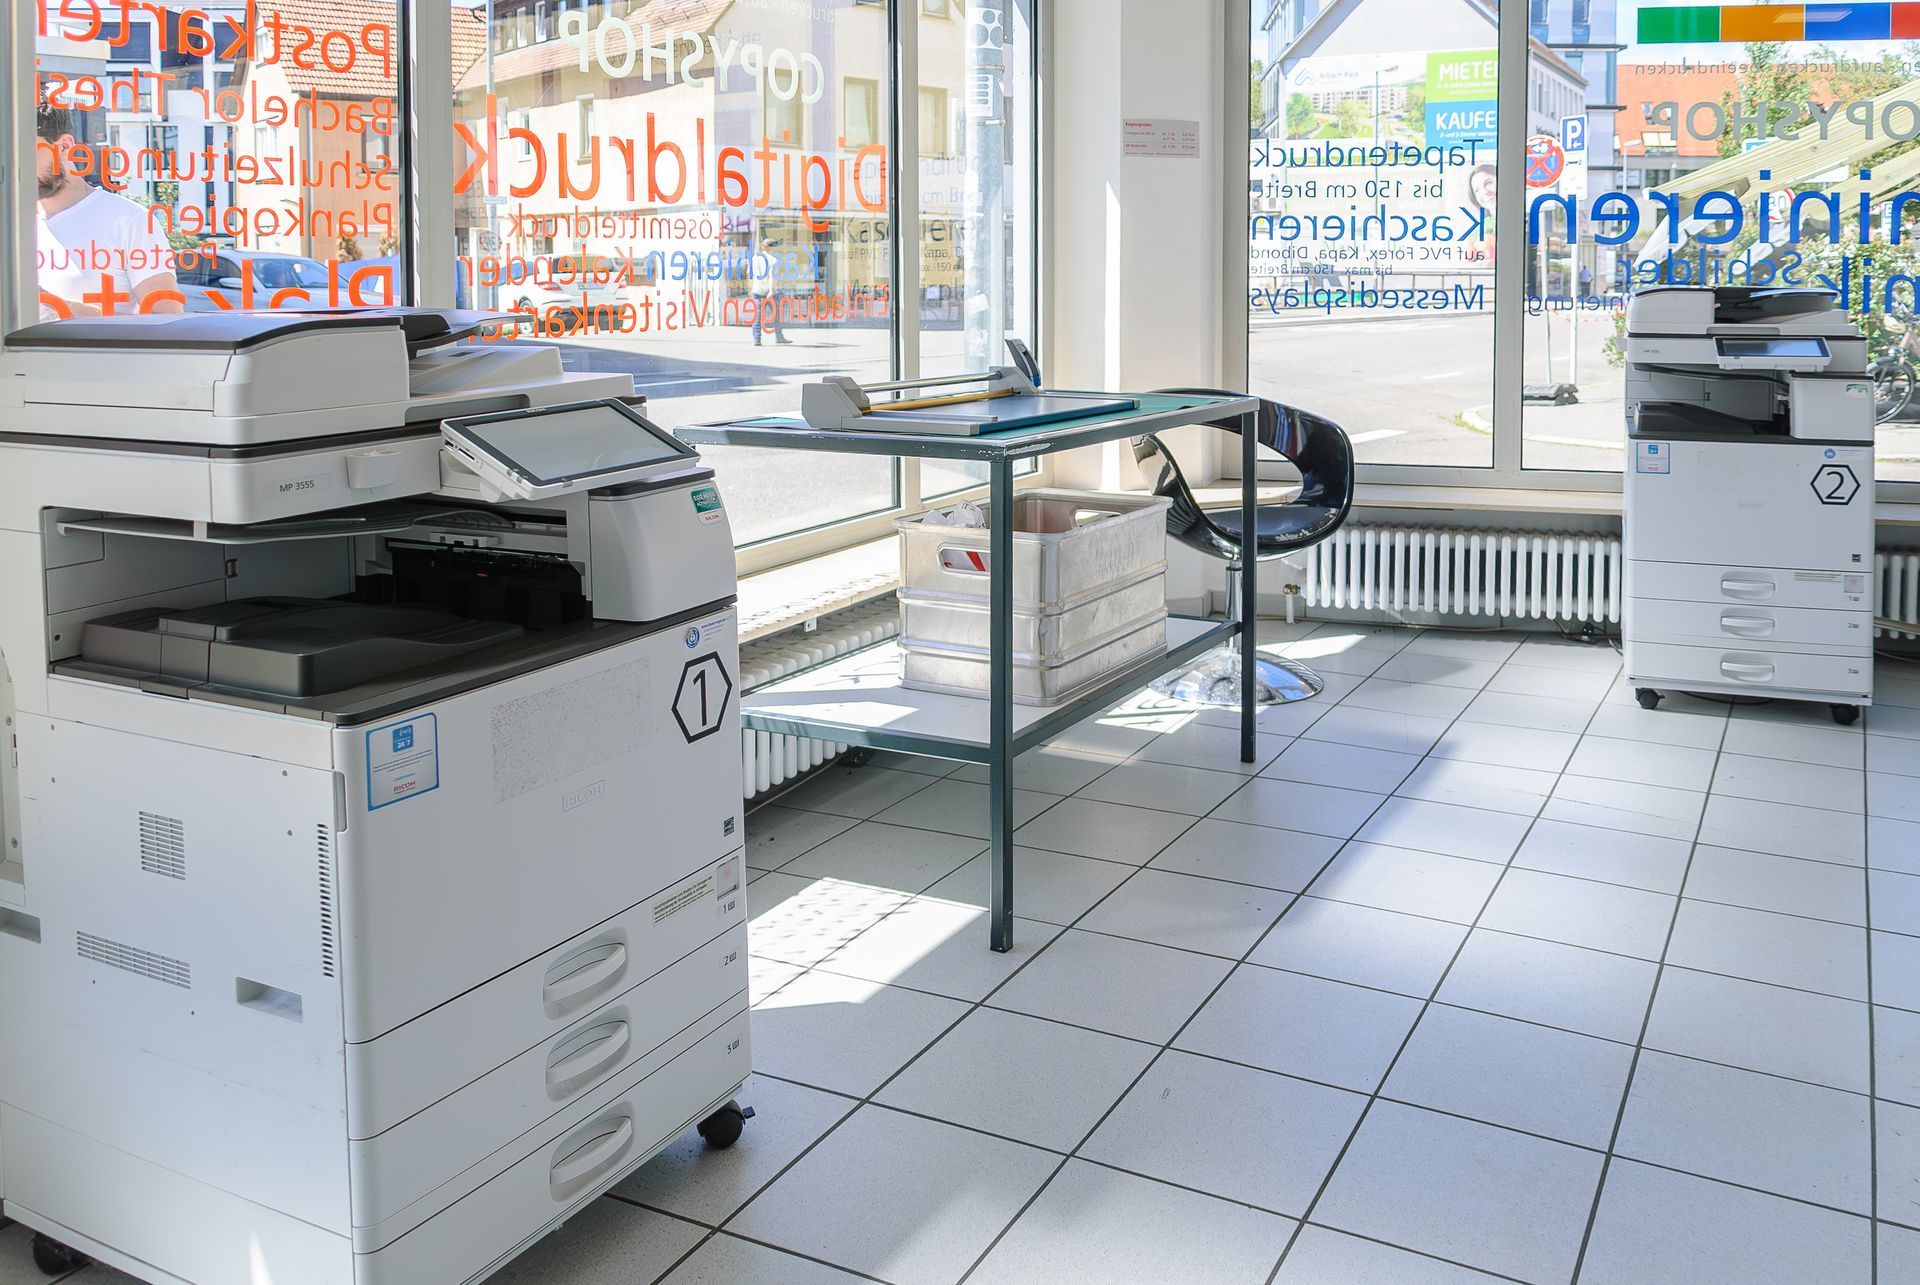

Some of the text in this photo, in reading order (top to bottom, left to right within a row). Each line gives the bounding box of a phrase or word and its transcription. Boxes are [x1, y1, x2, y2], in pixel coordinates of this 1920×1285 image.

[1566, 119, 1582, 150] P
[279, 480, 315, 492] MP 3555
[1825, 471, 1846, 500] 2
[692, 669, 708, 727] 1
[393, 780, 417, 793] RICOH
